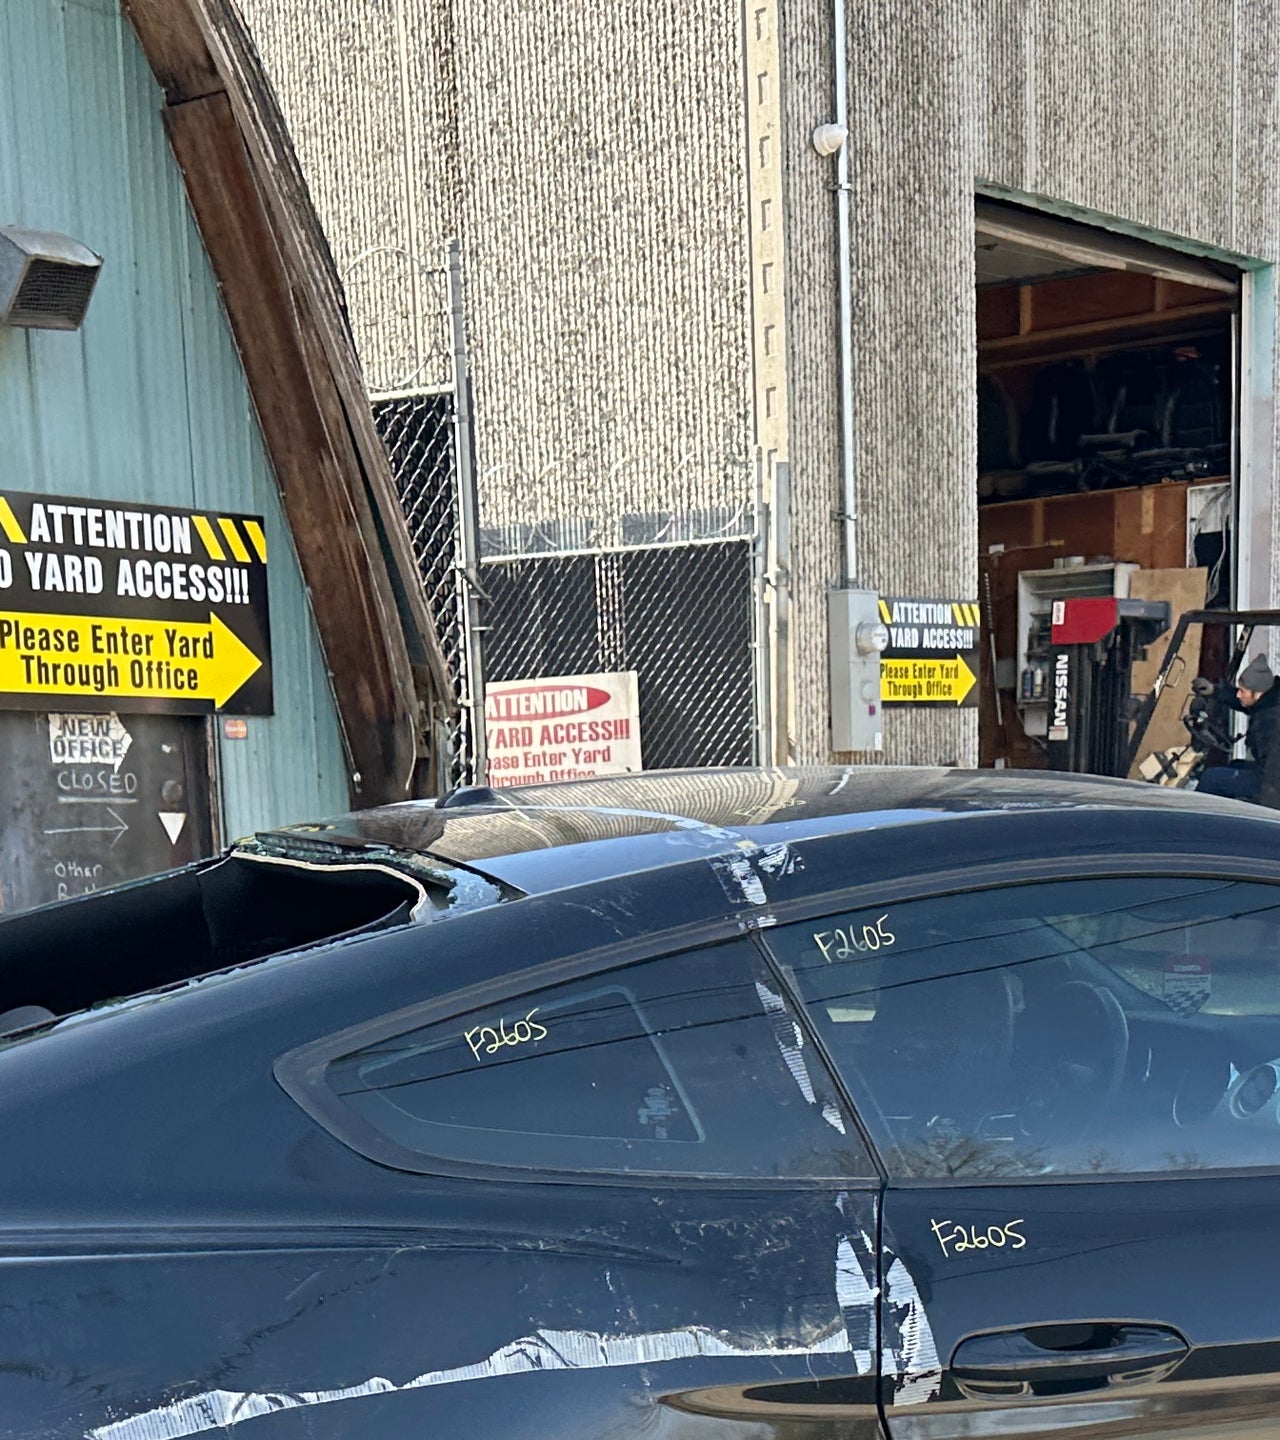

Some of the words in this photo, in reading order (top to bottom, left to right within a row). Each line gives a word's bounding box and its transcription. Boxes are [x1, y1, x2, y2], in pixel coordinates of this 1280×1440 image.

[30, 503, 191, 554] ATTENTION
[25, 551, 103, 594] YARD
[117, 559, 250, 604] ACCESS!!!
[892, 602, 952, 625] ATTENTION
[91, 624, 154, 656] Enter
[165, 629, 214, 659] Yard
[890, 627, 918, 649] YARD
[922, 628, 973, 649] ACCESS!!!
[20, 655, 119, 692] Through
[130, 659, 198, 690] Office
[880, 663, 909, 679] Please
[912, 663, 935, 679] Enter
[939, 663, 959, 680] Yard
[486, 688, 588, 718] ATTENTION
[887, 681, 922, 699] Through
[926, 680, 952, 696] Office
[1053, 654, 1069, 726] NISSAN
[61, 718, 111, 737] NEW
[539, 718, 631, 747] ACCESS!!!
[52, 737, 123, 758] OFFICE
[487, 754, 519, 771] ase
[523, 750, 567, 769] Enter
[571, 745, 611, 764] Yard
[57, 770, 138, 794] CLOSED
[813, 913, 895, 964] F2605
[464, 1007, 548, 1062] F2605
[930, 1218, 1027, 1258] F2605
